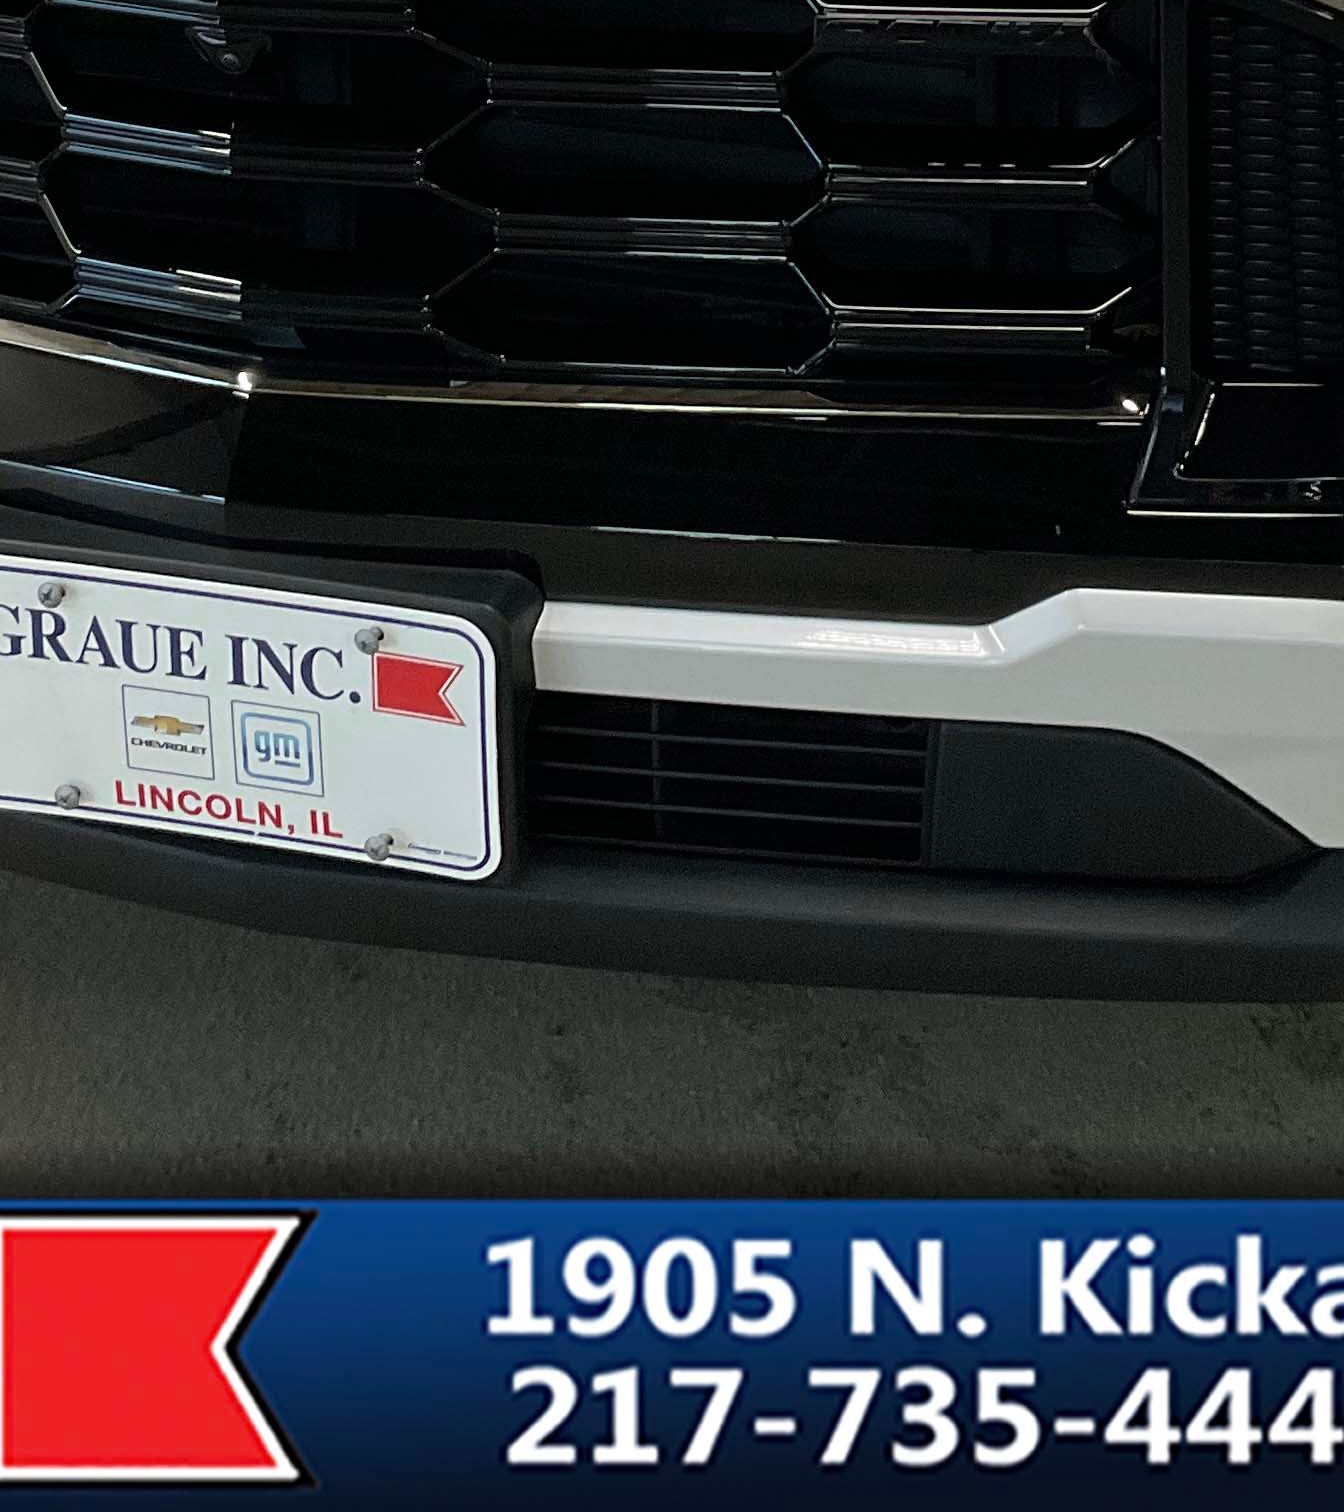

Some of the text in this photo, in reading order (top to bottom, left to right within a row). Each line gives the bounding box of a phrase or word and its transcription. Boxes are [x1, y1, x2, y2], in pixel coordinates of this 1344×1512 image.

[226, 633, 362, 704] INC.
[130, 736, 208, 756] CHEVROLET
[253, 729, 301, 766] gm
[114, 780, 344, 838] LINCOLN, IL
